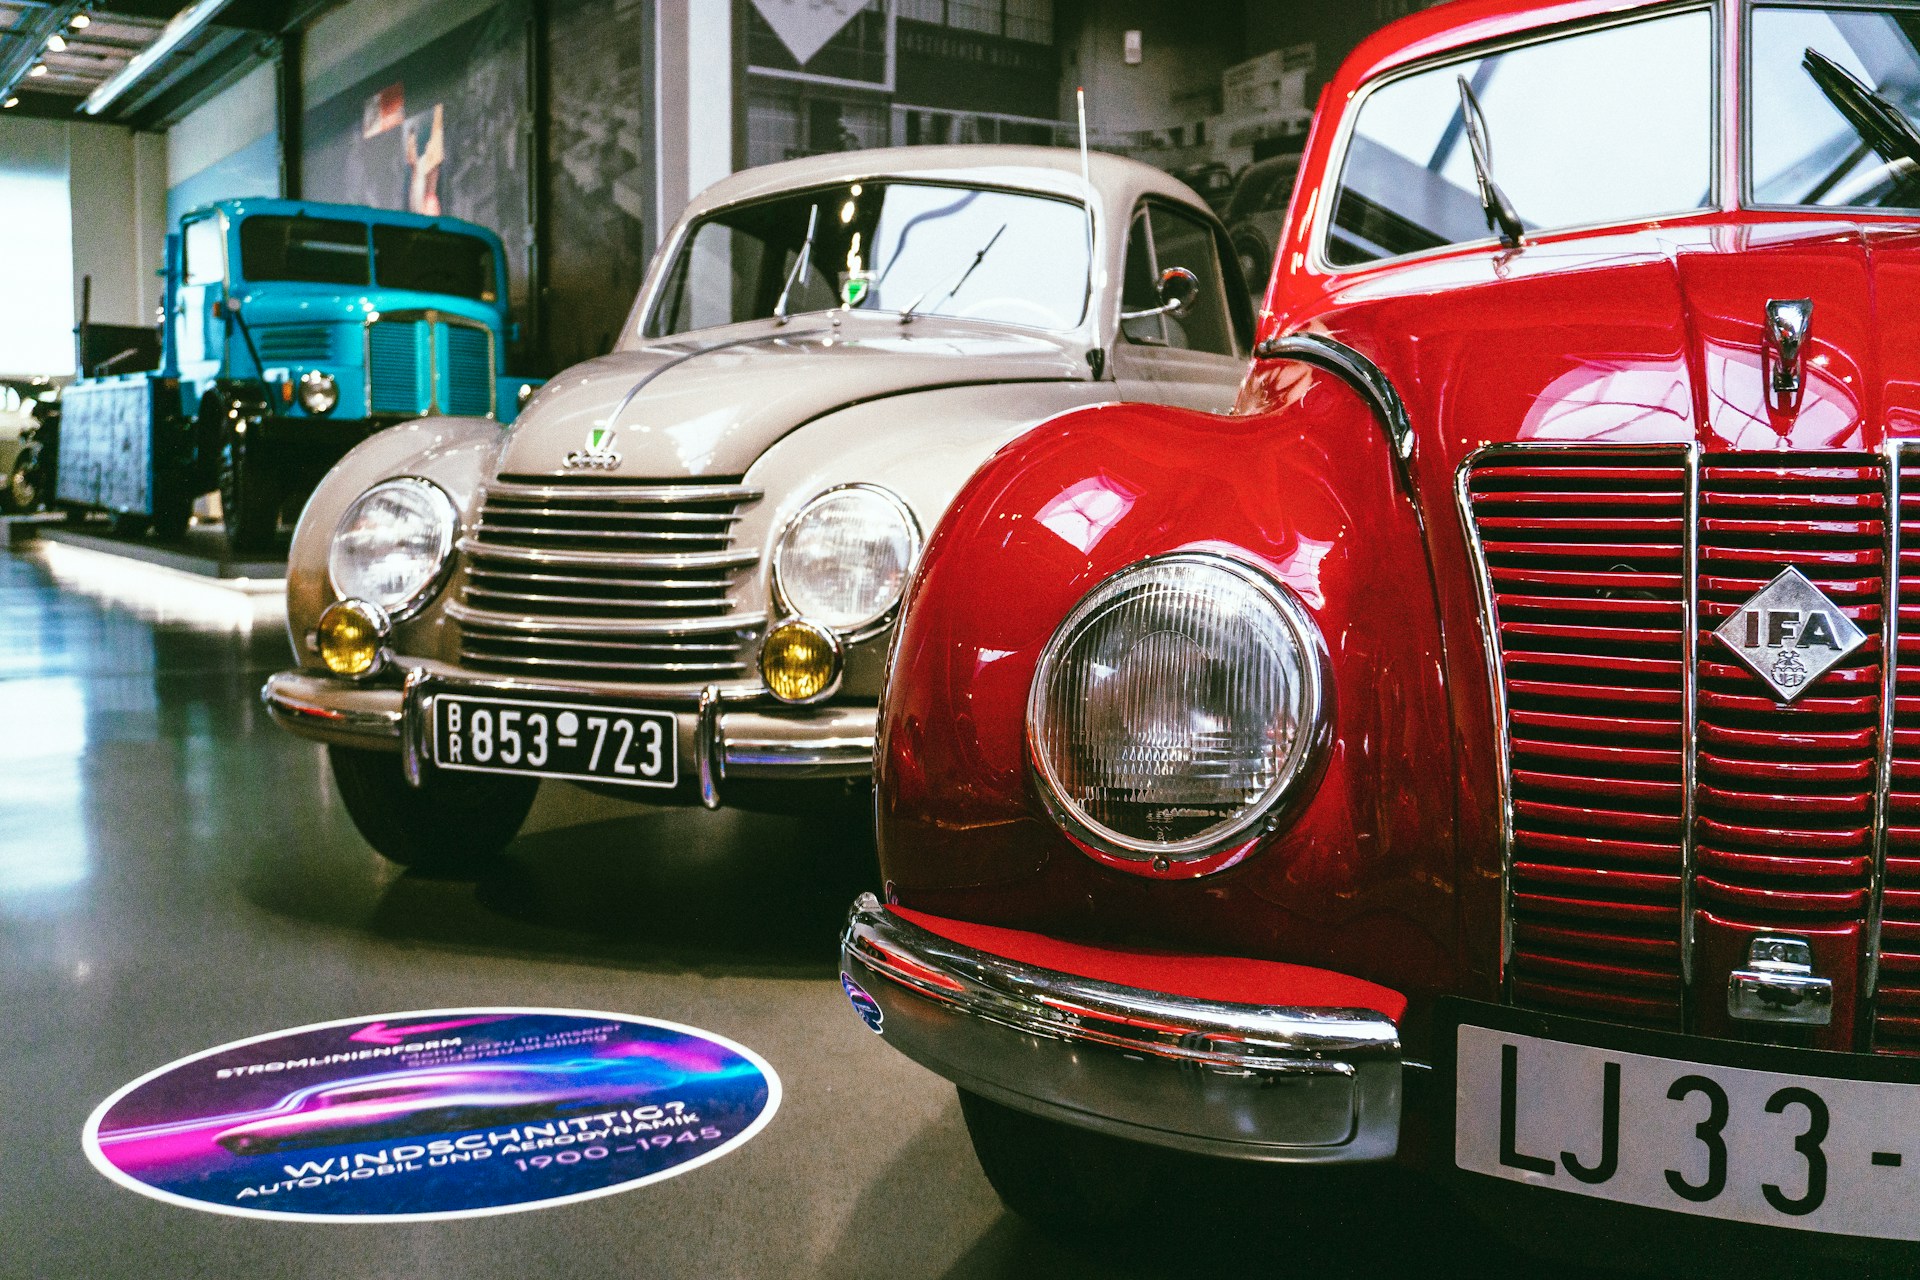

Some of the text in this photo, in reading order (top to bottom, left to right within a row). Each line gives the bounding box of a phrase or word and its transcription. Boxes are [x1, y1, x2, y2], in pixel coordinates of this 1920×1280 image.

[1743, 609, 1843, 651] IFA
[216, 1037, 463, 1079] STROMLINIENFORM
[283, 1101, 686, 1178] WINDSCHNITTIG?
[1499, 1043, 1621, 1184] LJ
[236, 1111, 700, 1200] AUTOMOBIL UND AERODYNAMIK
